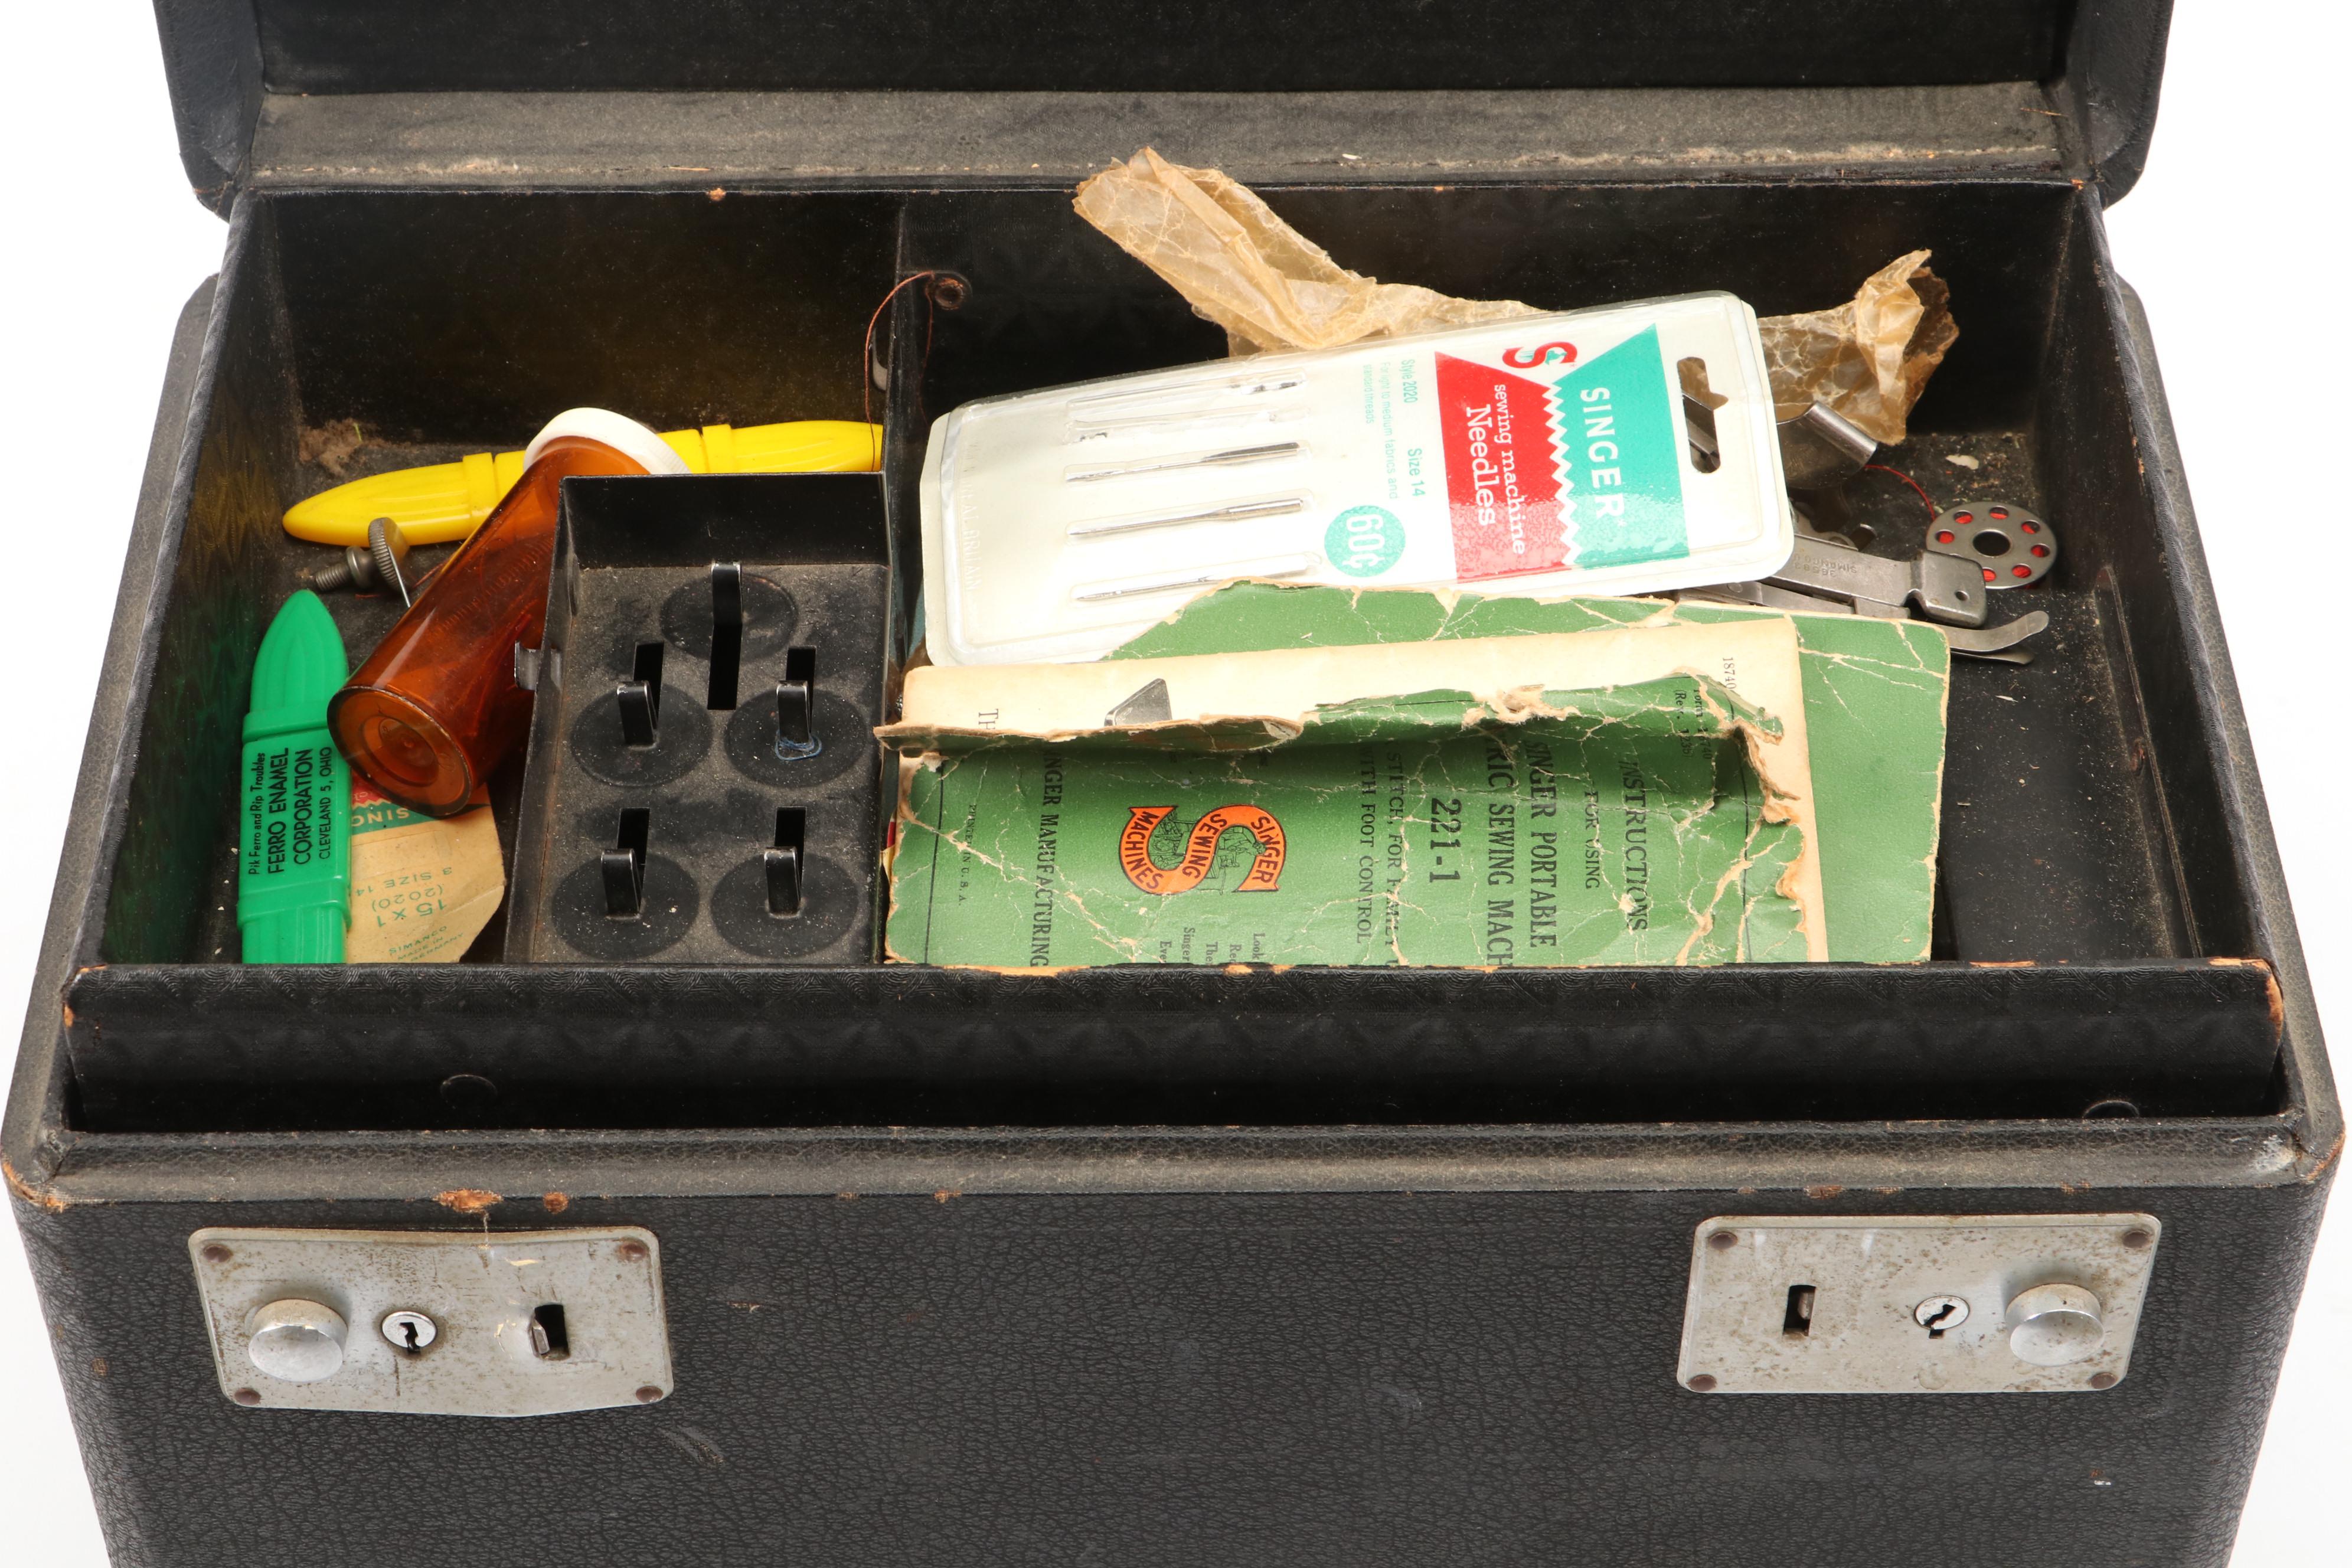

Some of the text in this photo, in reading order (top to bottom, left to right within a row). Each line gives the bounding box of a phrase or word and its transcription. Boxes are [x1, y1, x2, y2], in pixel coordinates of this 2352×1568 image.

[1363, 364, 1376, 424] standard threads
[1380, 362, 1391, 374] For
[1399, 359, 1418, 403] Style 2020
[1381, 401, 1394, 436] medium
[1384, 439, 1397, 474] fabrics
[1407, 447, 1426, 497] Size 14
[1466, 404, 1496, 527] Needles
[1495, 384, 1526, 555] sewing machine
[1581, 387, 1625, 520] SINGER
[1388, 478, 1399, 500] and
[1346, 512, 1386, 569] 60¢
[249, 752, 265, 875] Pik Ferro and Rip Troubles
[267, 747, 289, 874] FERRO ENAMEL
[293, 748, 313, 865] CORPORATION
[319, 746, 333, 860] CLEVELAND 5, OHIO
[351, 807, 410, 827] SING
[1387, 751, 1404, 825] STITCH,
[962, 851, 972, 863] IN
[1128, 810, 1163, 890] MACHINES
[1182, 813, 1228, 880] SEWING
[1251, 815, 1283, 883] SINGER
[1356, 748, 1376, 945] WITH FOOT CONTROL
[1387, 833, 1403, 869] FOR
[1429, 797, 1463, 884] 221-1
[1488, 803, 1515, 886] SEWING
[1525, 740, 1558, 948] SINGER PORTABLE
[1584, 791, 1600, 889] FOR USING
[1618, 760, 1648, 931] INSTRUCTIONS
[355, 867, 452, 896] 3 SIZE 14
[372, 884, 443, 912] (2020)
[416, 899, 447, 916] 15
[1030, 814, 1060, 966] MANUFACTURING
[377, 916, 386, 927] 1
[388, 925, 447, 954] SIMANCO
[1181, 927, 1196, 962] Singer
[1252, 933, 1266, 961] Look
